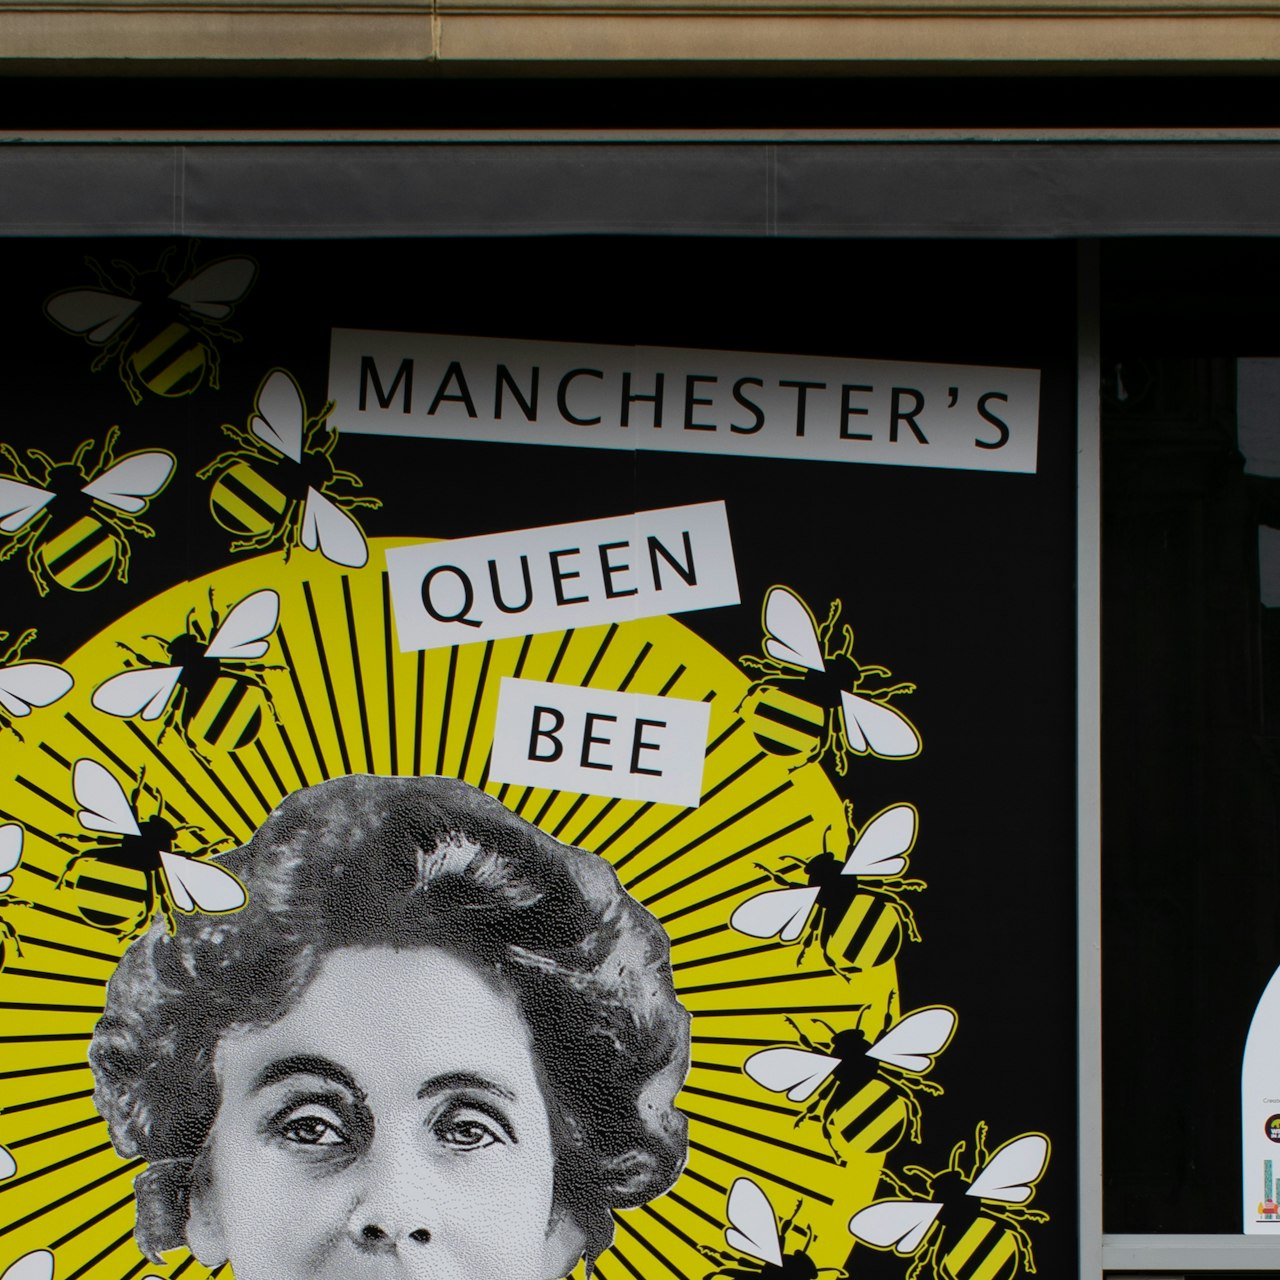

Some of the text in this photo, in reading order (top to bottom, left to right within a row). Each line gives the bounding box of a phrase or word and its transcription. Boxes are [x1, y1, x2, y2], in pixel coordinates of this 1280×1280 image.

[357, 355, 1011, 450] MANCHESTER'S
[420, 530, 698, 628] QUEEN
[527, 705, 668, 777] BEE
